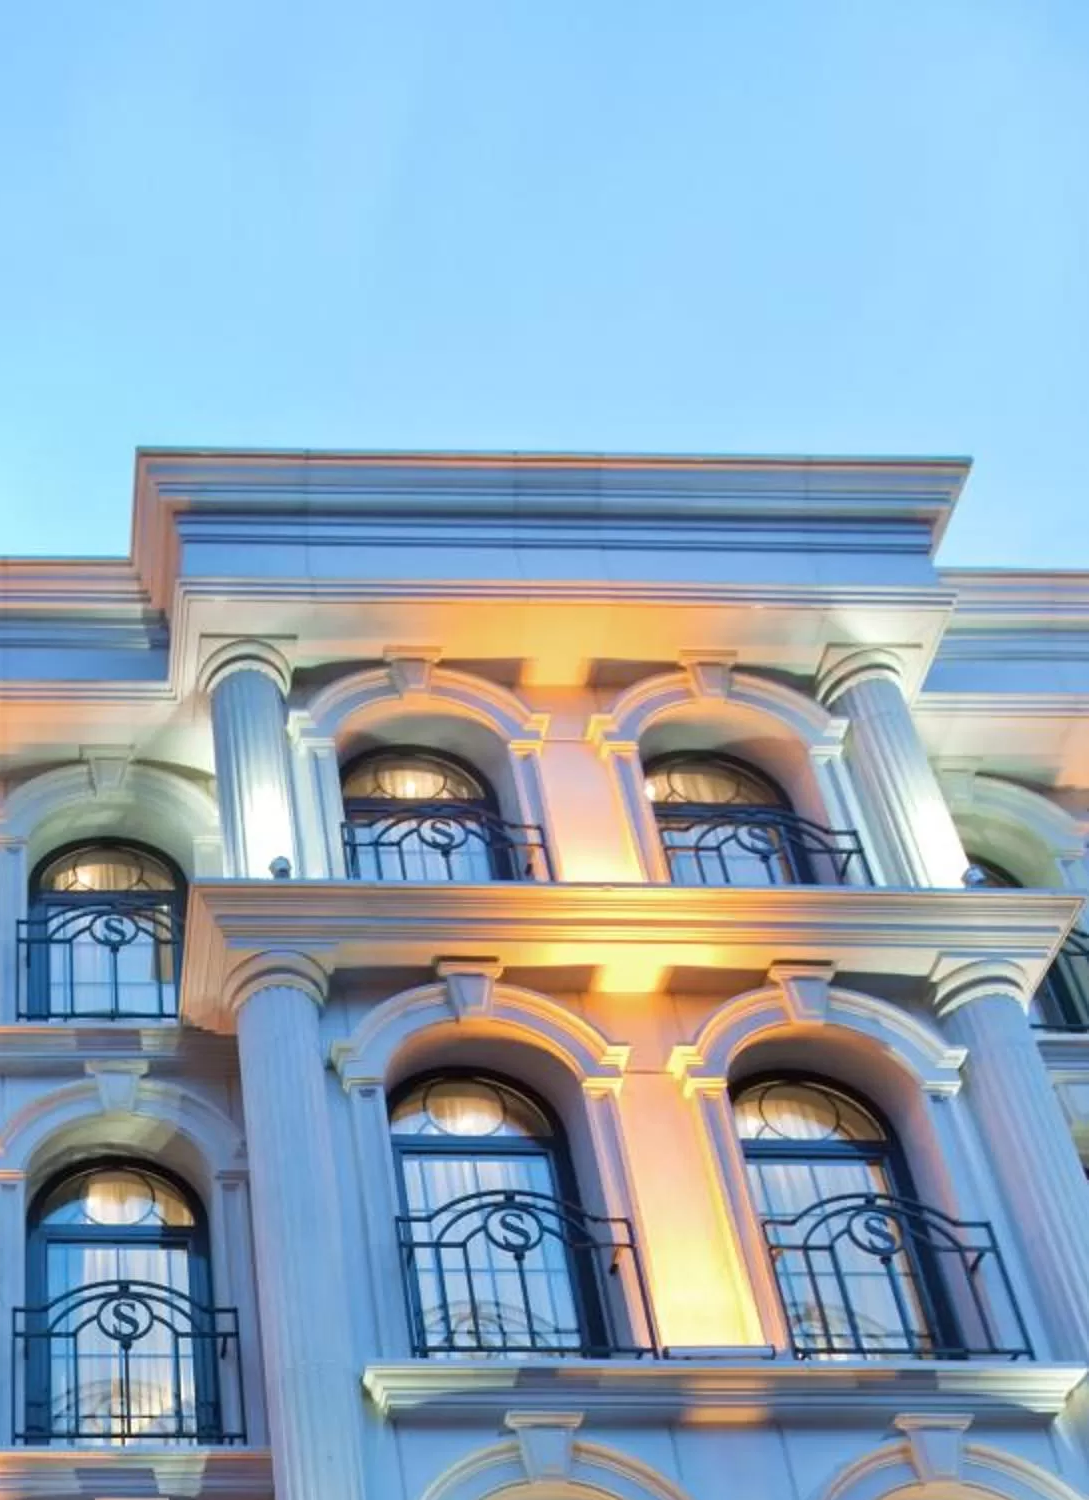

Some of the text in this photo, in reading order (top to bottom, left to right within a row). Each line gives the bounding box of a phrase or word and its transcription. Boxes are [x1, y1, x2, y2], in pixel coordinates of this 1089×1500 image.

[430, 821, 455, 846] S
[746, 828, 771, 853] S
[104, 917, 126, 942] S
[500, 1213, 531, 1250] S
[865, 1216, 895, 1253] S
[113, 1301, 139, 1338] S
